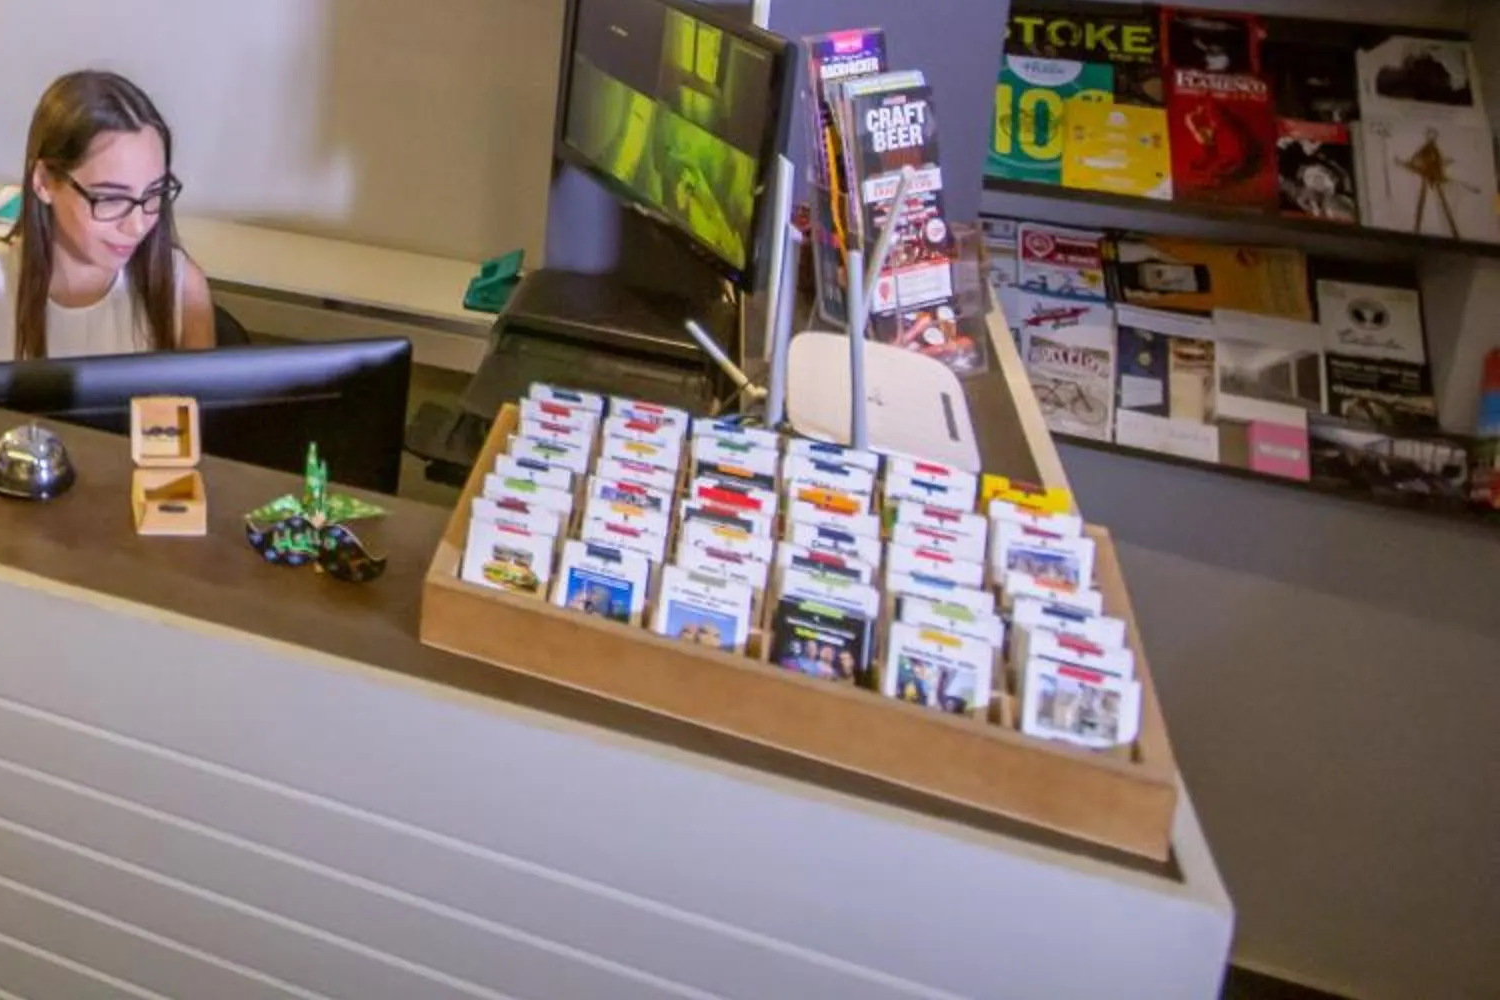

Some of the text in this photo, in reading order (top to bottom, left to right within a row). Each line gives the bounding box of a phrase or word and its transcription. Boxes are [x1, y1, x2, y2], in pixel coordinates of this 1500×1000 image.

[1003, 16, 1155, 54] TOKE
[866, 101, 927, 132] CRAFT
[873, 123, 924, 153] BEER
